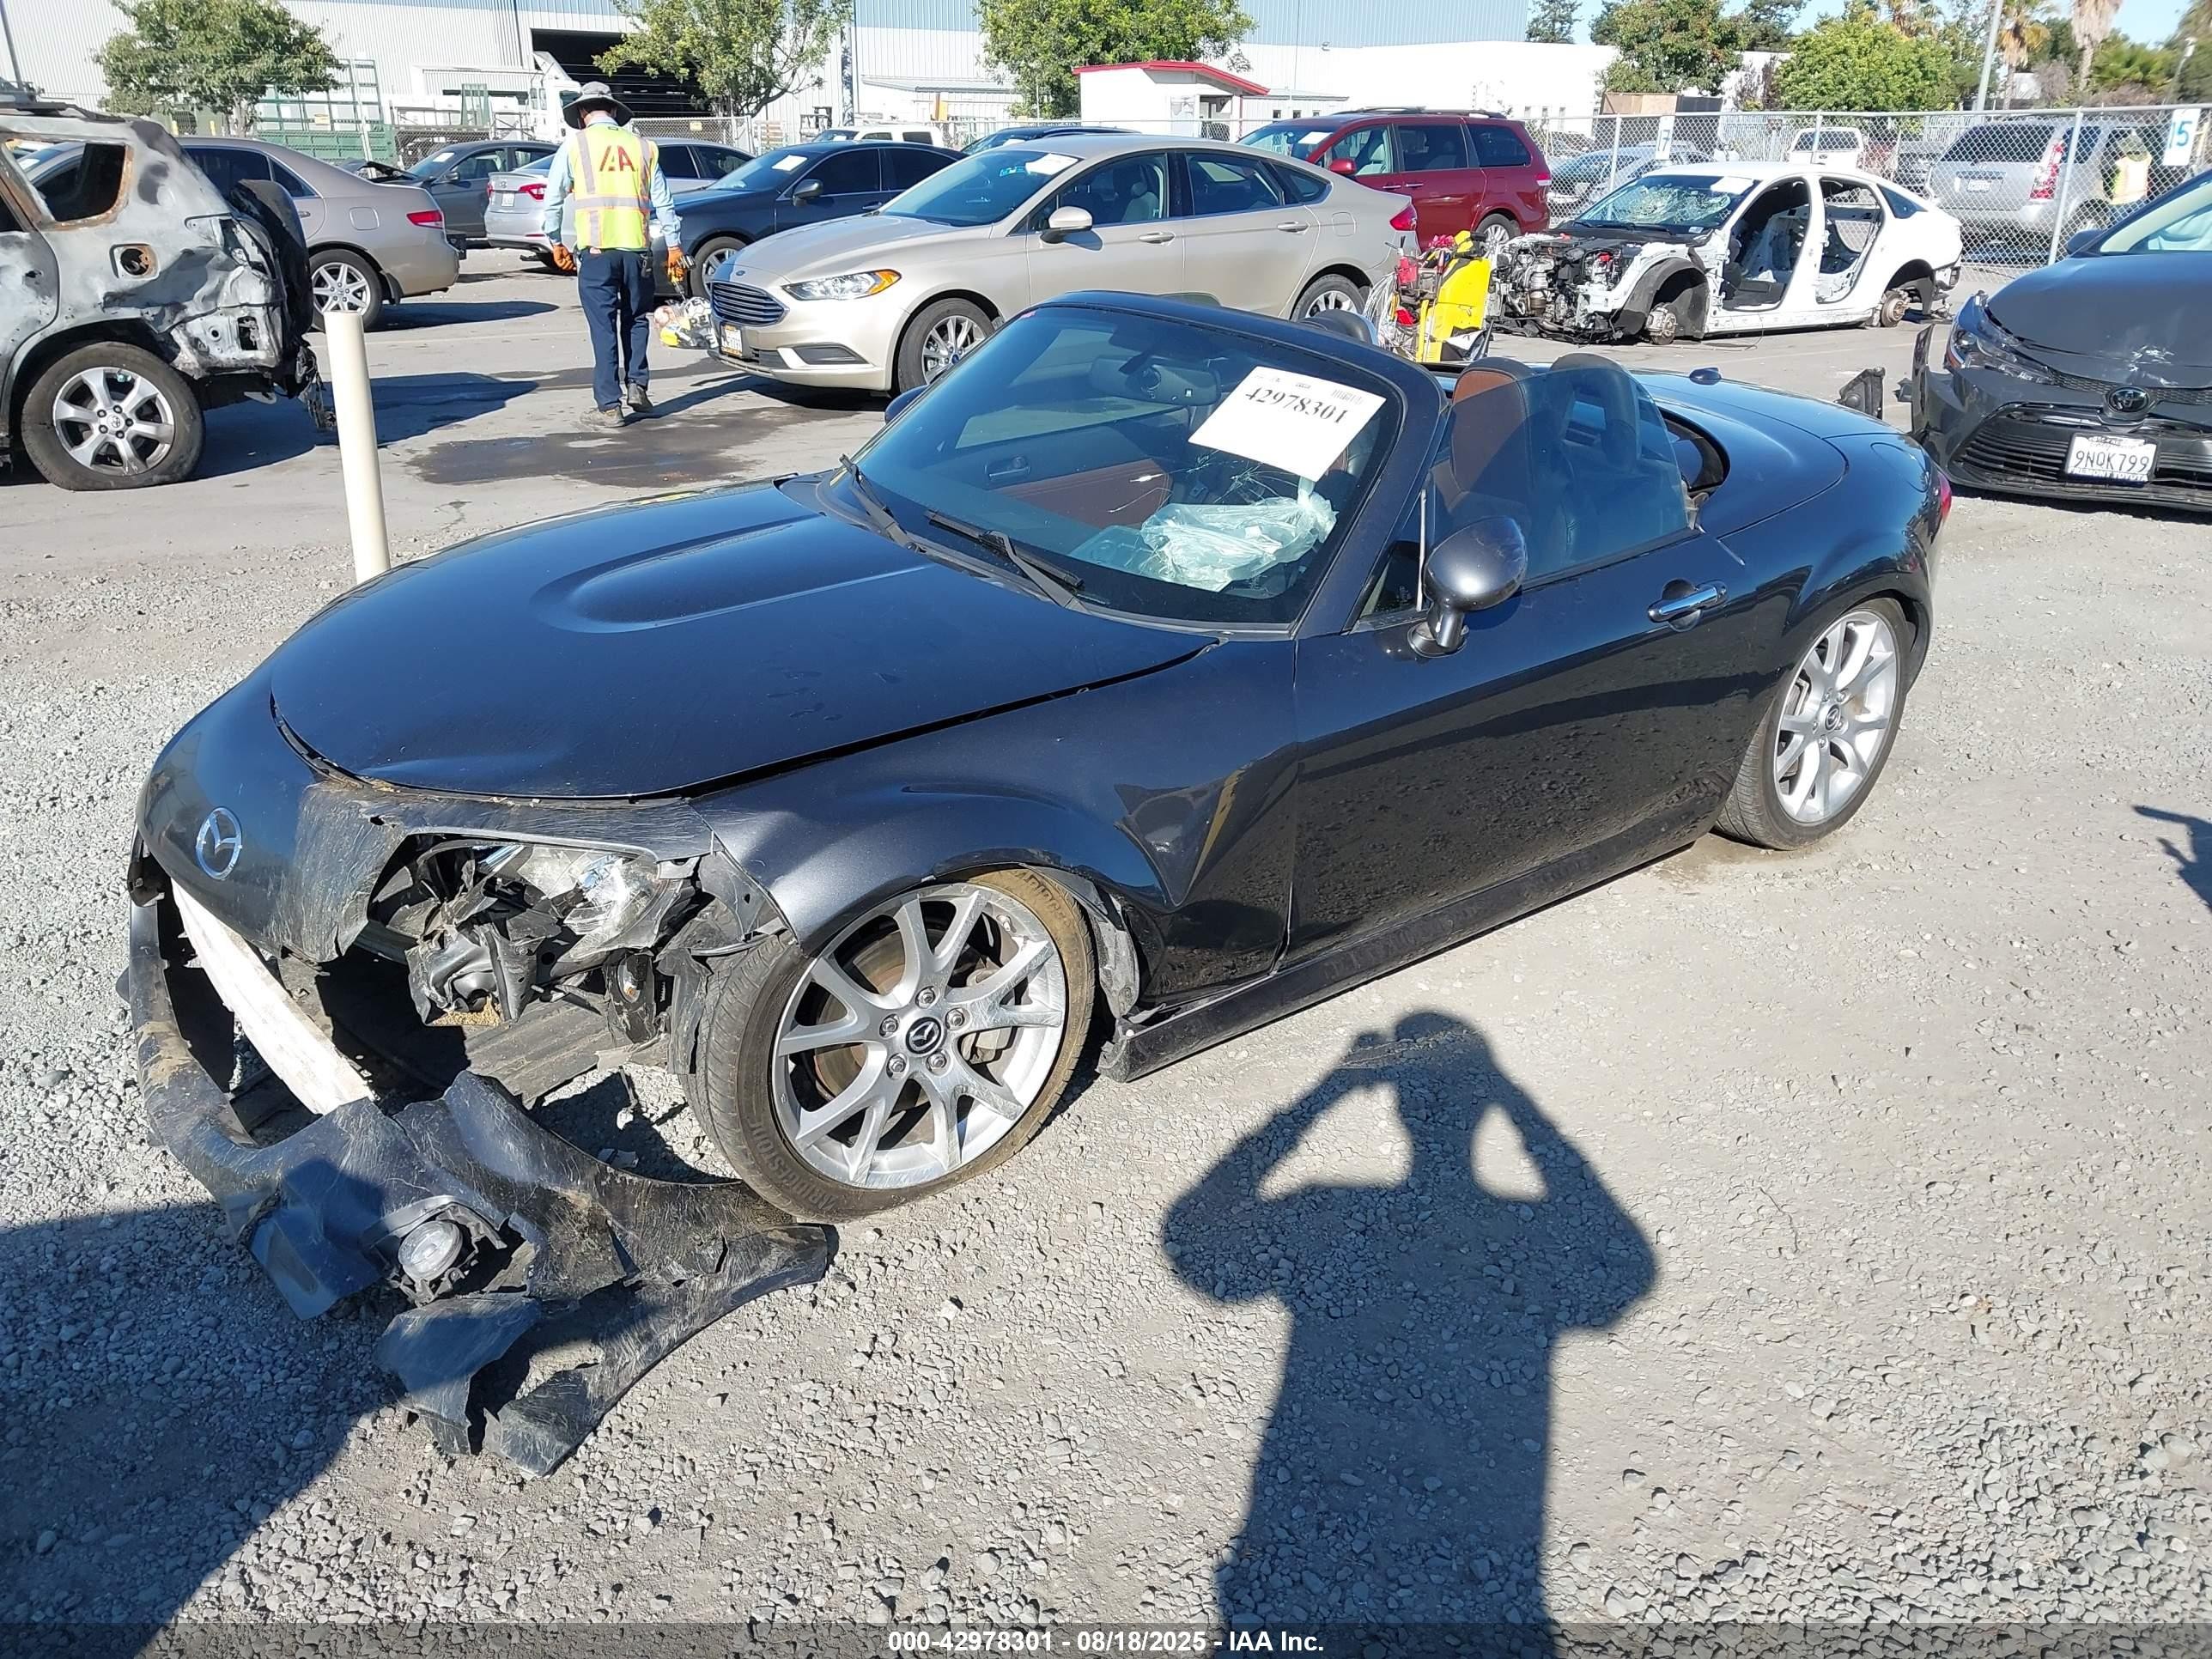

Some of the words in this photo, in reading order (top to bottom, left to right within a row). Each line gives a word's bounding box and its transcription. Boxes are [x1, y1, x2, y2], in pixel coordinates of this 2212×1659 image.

[1657, 130, 1671, 152] 17
[2169, 121, 2192, 149] 15
[1245, 387, 1349, 423] 42978301
[2068, 467, 2112, 478] FREMONT
[2113, 471, 2148, 482] TOYOTA
